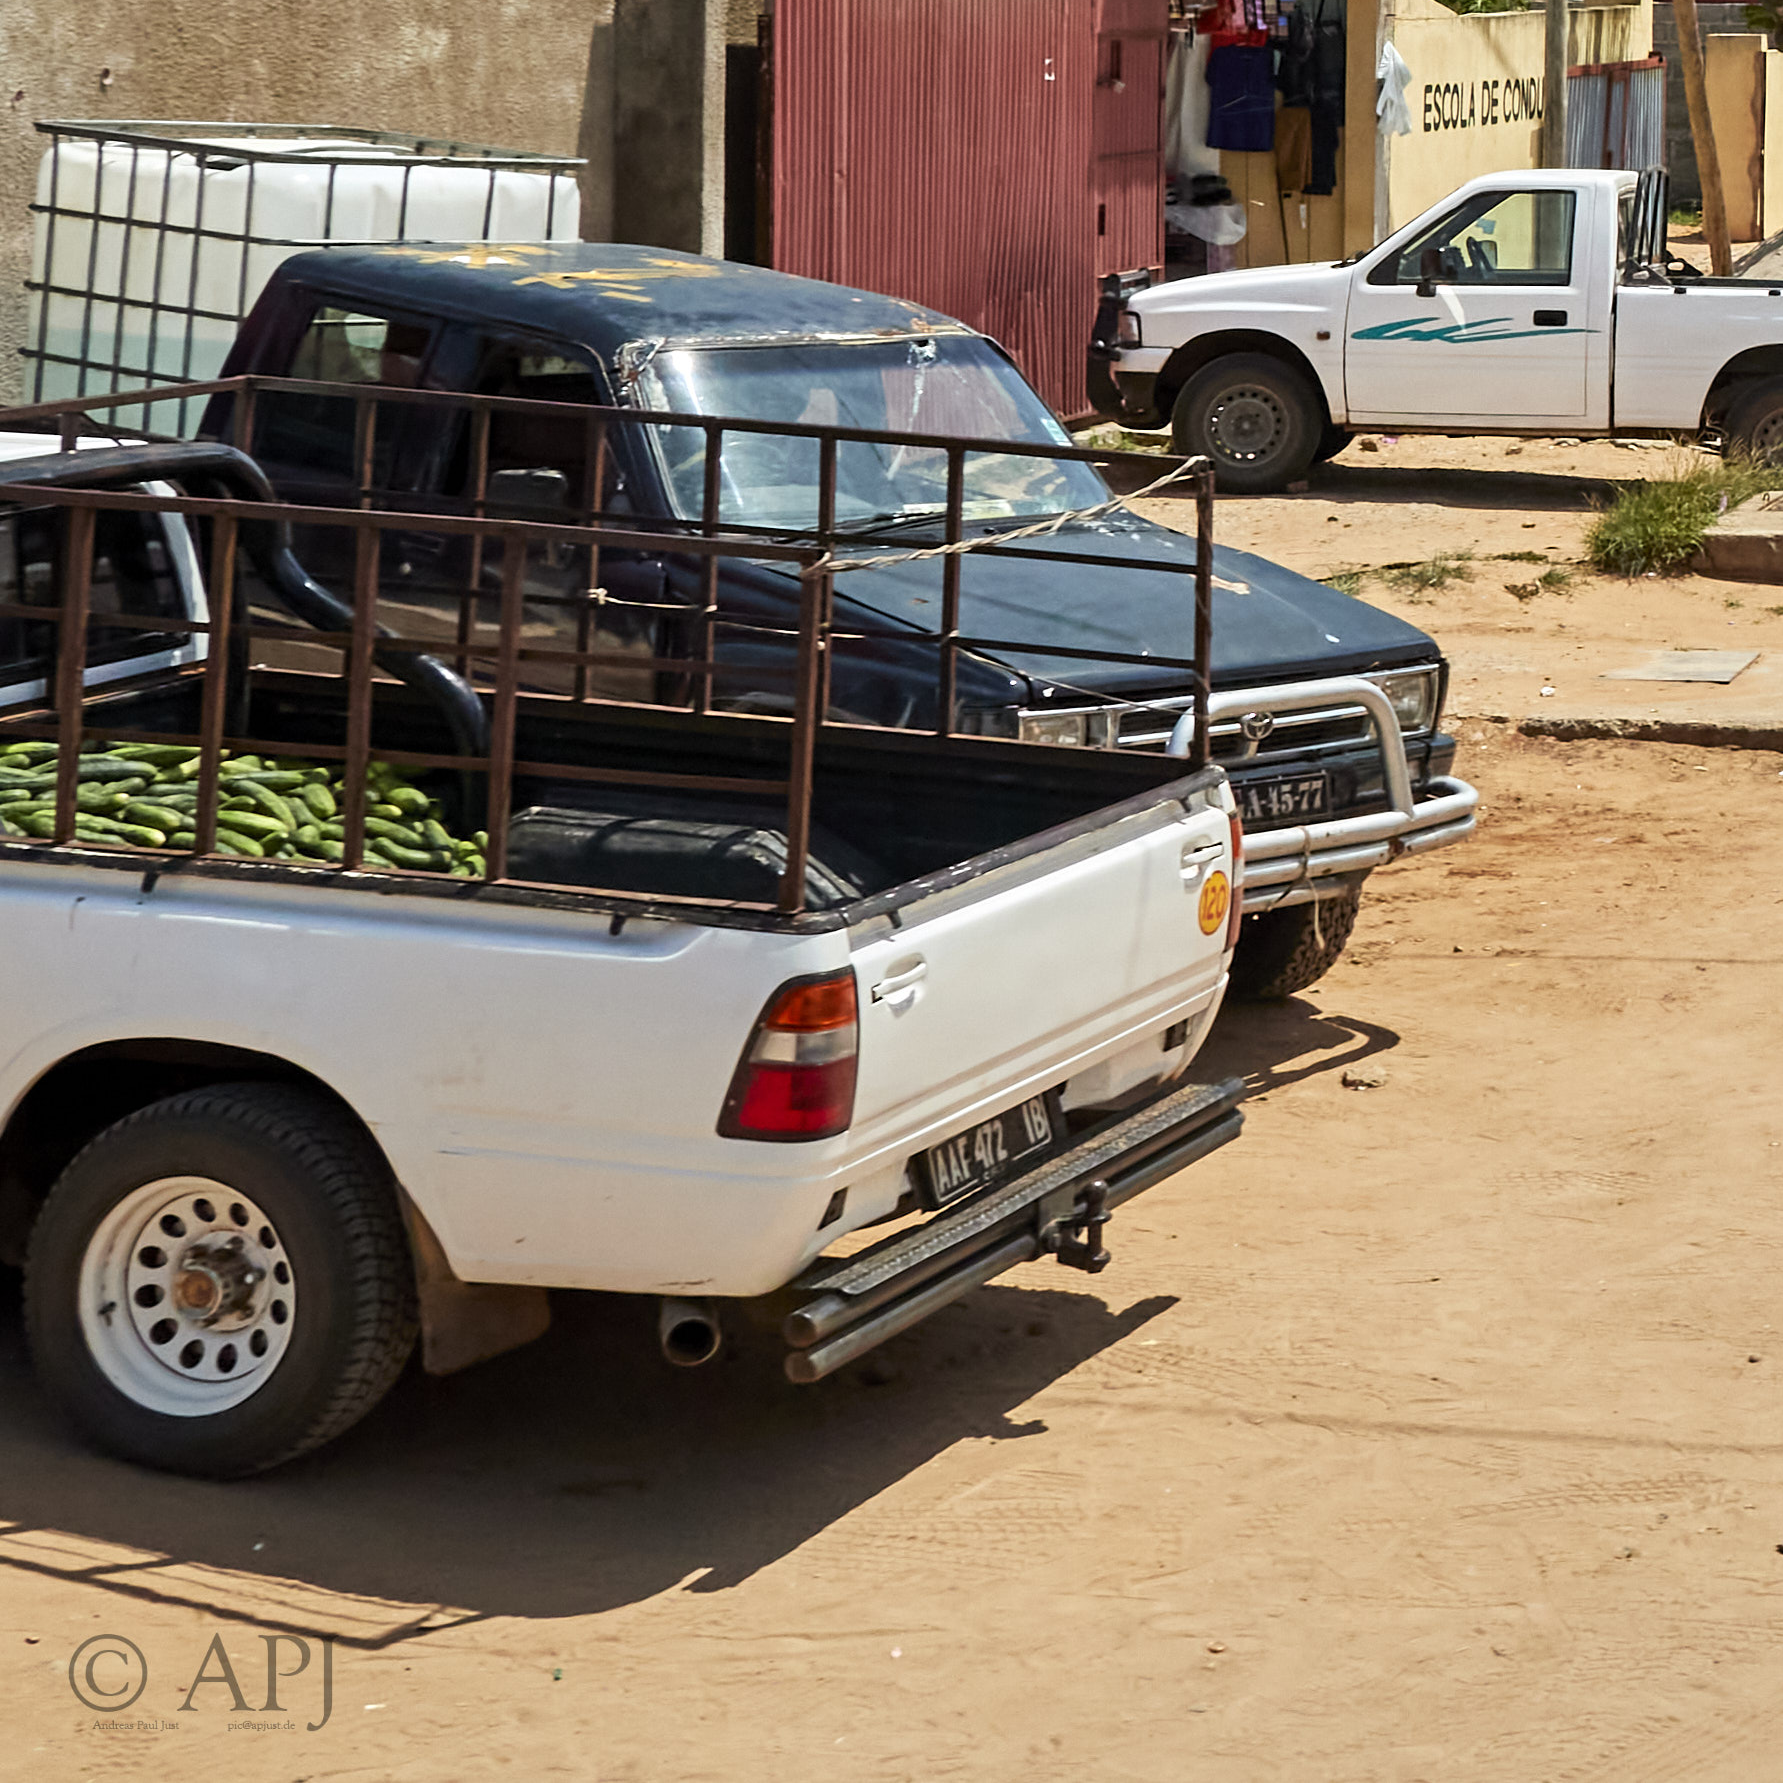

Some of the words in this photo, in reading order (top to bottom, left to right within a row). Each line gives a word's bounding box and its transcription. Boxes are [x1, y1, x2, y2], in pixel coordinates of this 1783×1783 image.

[1423, 82, 1476, 132] ESCOLA
[1481, 80, 1499, 126] DE
[1503, 77, 1545, 123] CONDU
[1236, 779, 1324, 820] A-45-77
[1202, 884, 1228, 921] 120
[936, 1135, 973, 1194] AAF
[974, 1119, 1009, 1169] 472
